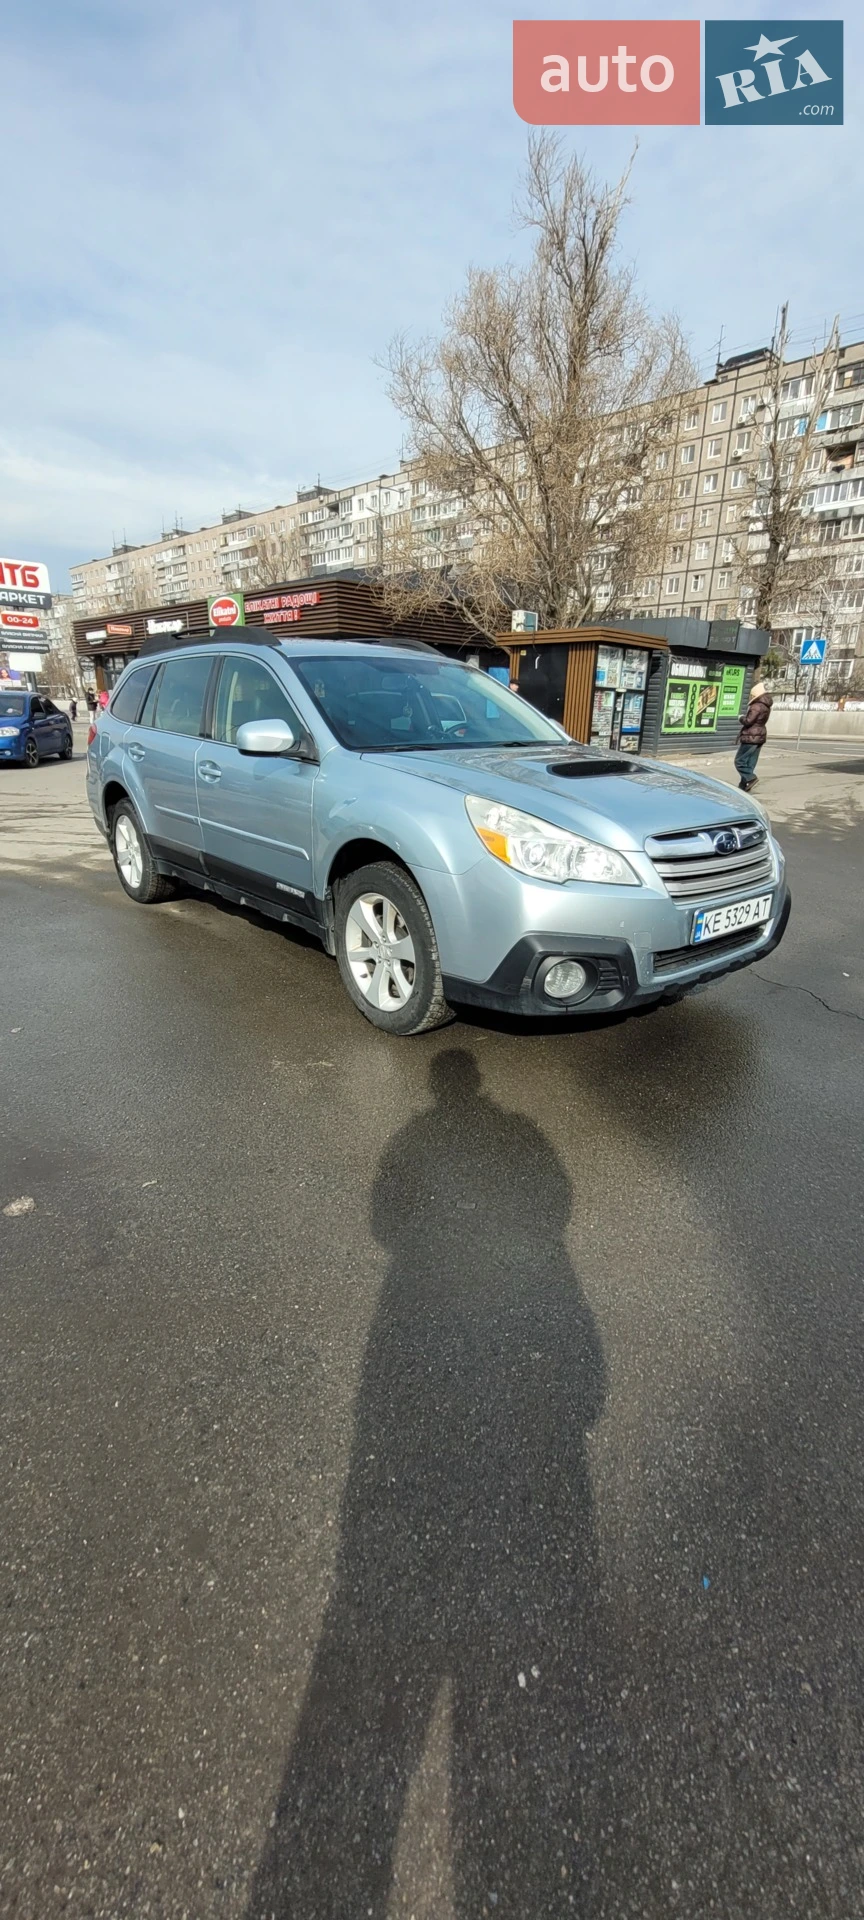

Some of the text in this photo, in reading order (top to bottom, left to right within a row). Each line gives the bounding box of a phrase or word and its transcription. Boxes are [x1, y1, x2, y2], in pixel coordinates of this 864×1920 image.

[0, 591, 46, 605] АРКЕТ
[6, 616, 34, 625] 00-24
[703, 912, 722, 937] KE
[724, 904, 751, 929] 5329
